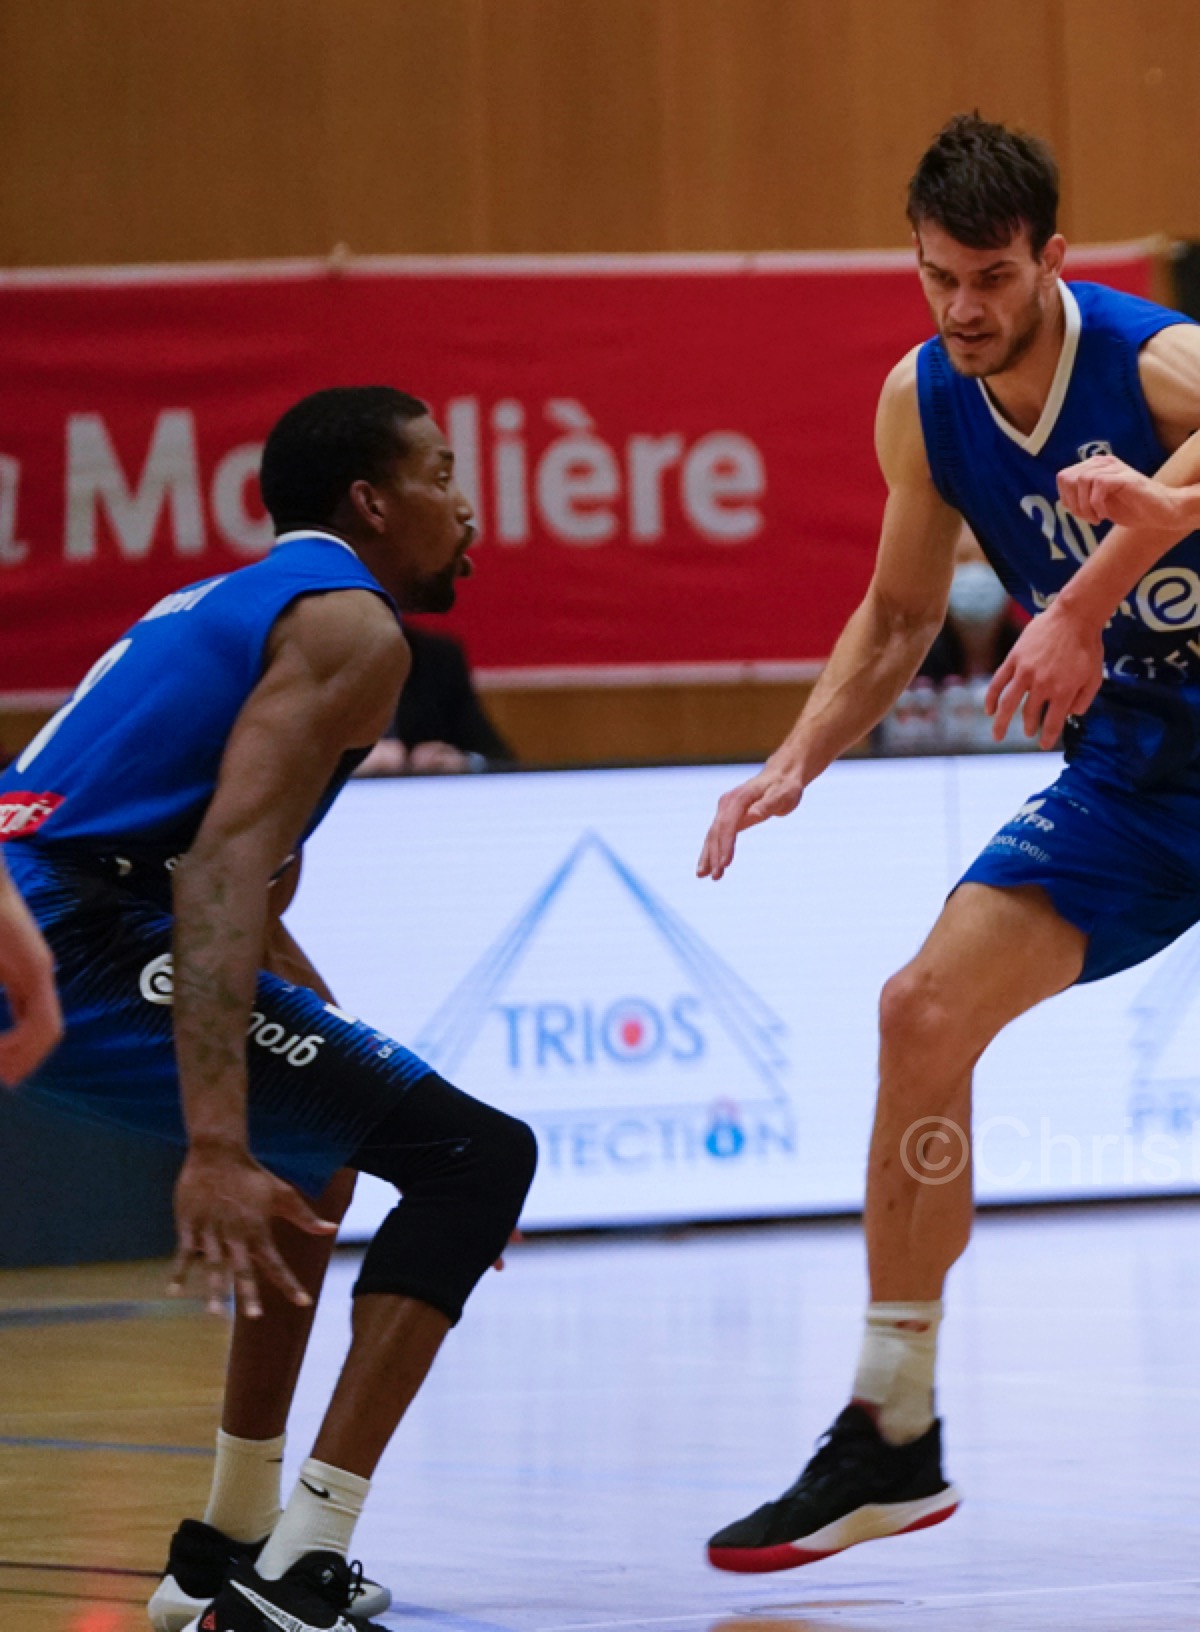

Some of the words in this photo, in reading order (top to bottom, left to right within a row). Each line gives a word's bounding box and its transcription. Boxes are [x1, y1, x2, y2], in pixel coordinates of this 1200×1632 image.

[64, 396, 766, 564] Molière
[500, 997, 706, 1068] TRIOS
[543, 1098, 797, 1168] TECTION
